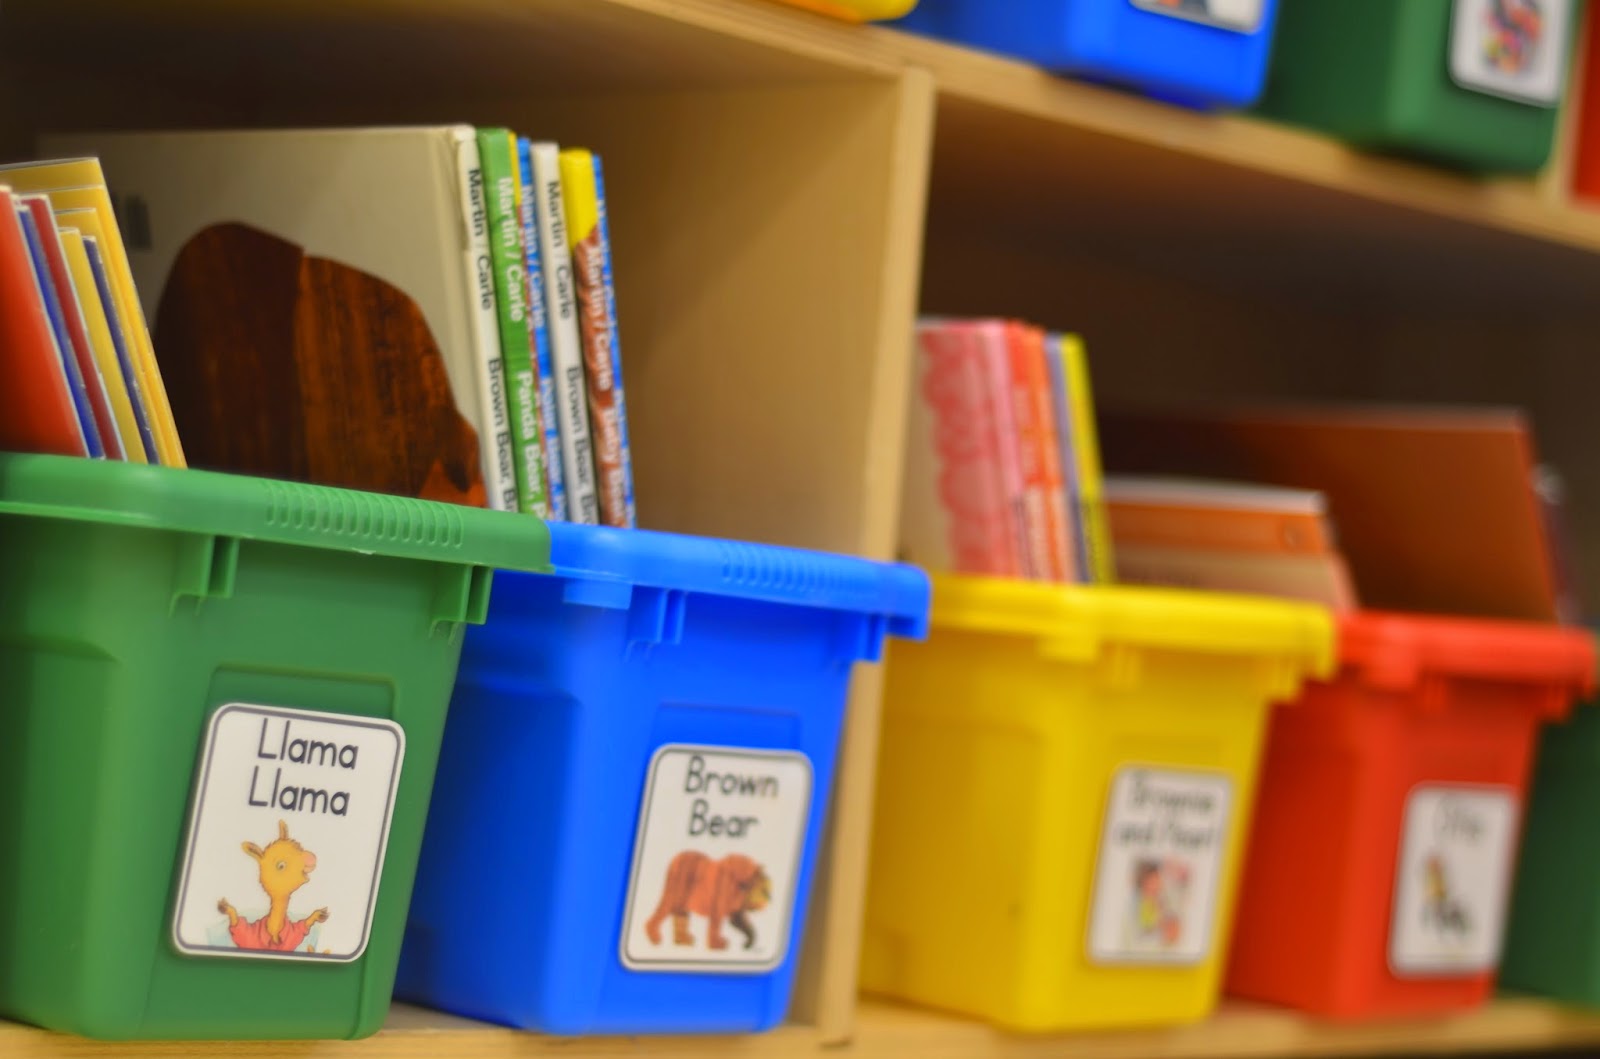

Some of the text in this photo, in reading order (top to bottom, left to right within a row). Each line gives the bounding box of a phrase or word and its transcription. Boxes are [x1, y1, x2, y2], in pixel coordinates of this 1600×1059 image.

[469, 168, 487, 237] Martin
[498, 176, 518, 248] Martin
[477, 255, 493, 311] Carle
[506, 263, 525, 323] Carle
[546, 181, 565, 248] Martin
[556, 265, 573, 320] Carle
[566, 366, 584, 435] Brown
[586, 245, 606, 316] Martin
[593, 333, 613, 391] Carle
[488, 358, 505, 427] Brown
[517, 371, 536, 441] Panda
[602, 408, 620, 465] Baby
[258, 717, 359, 770] Llama
[248, 765, 350, 816] Llama
[684, 754, 779, 798] Brown
[688, 798, 760, 838] Bear
